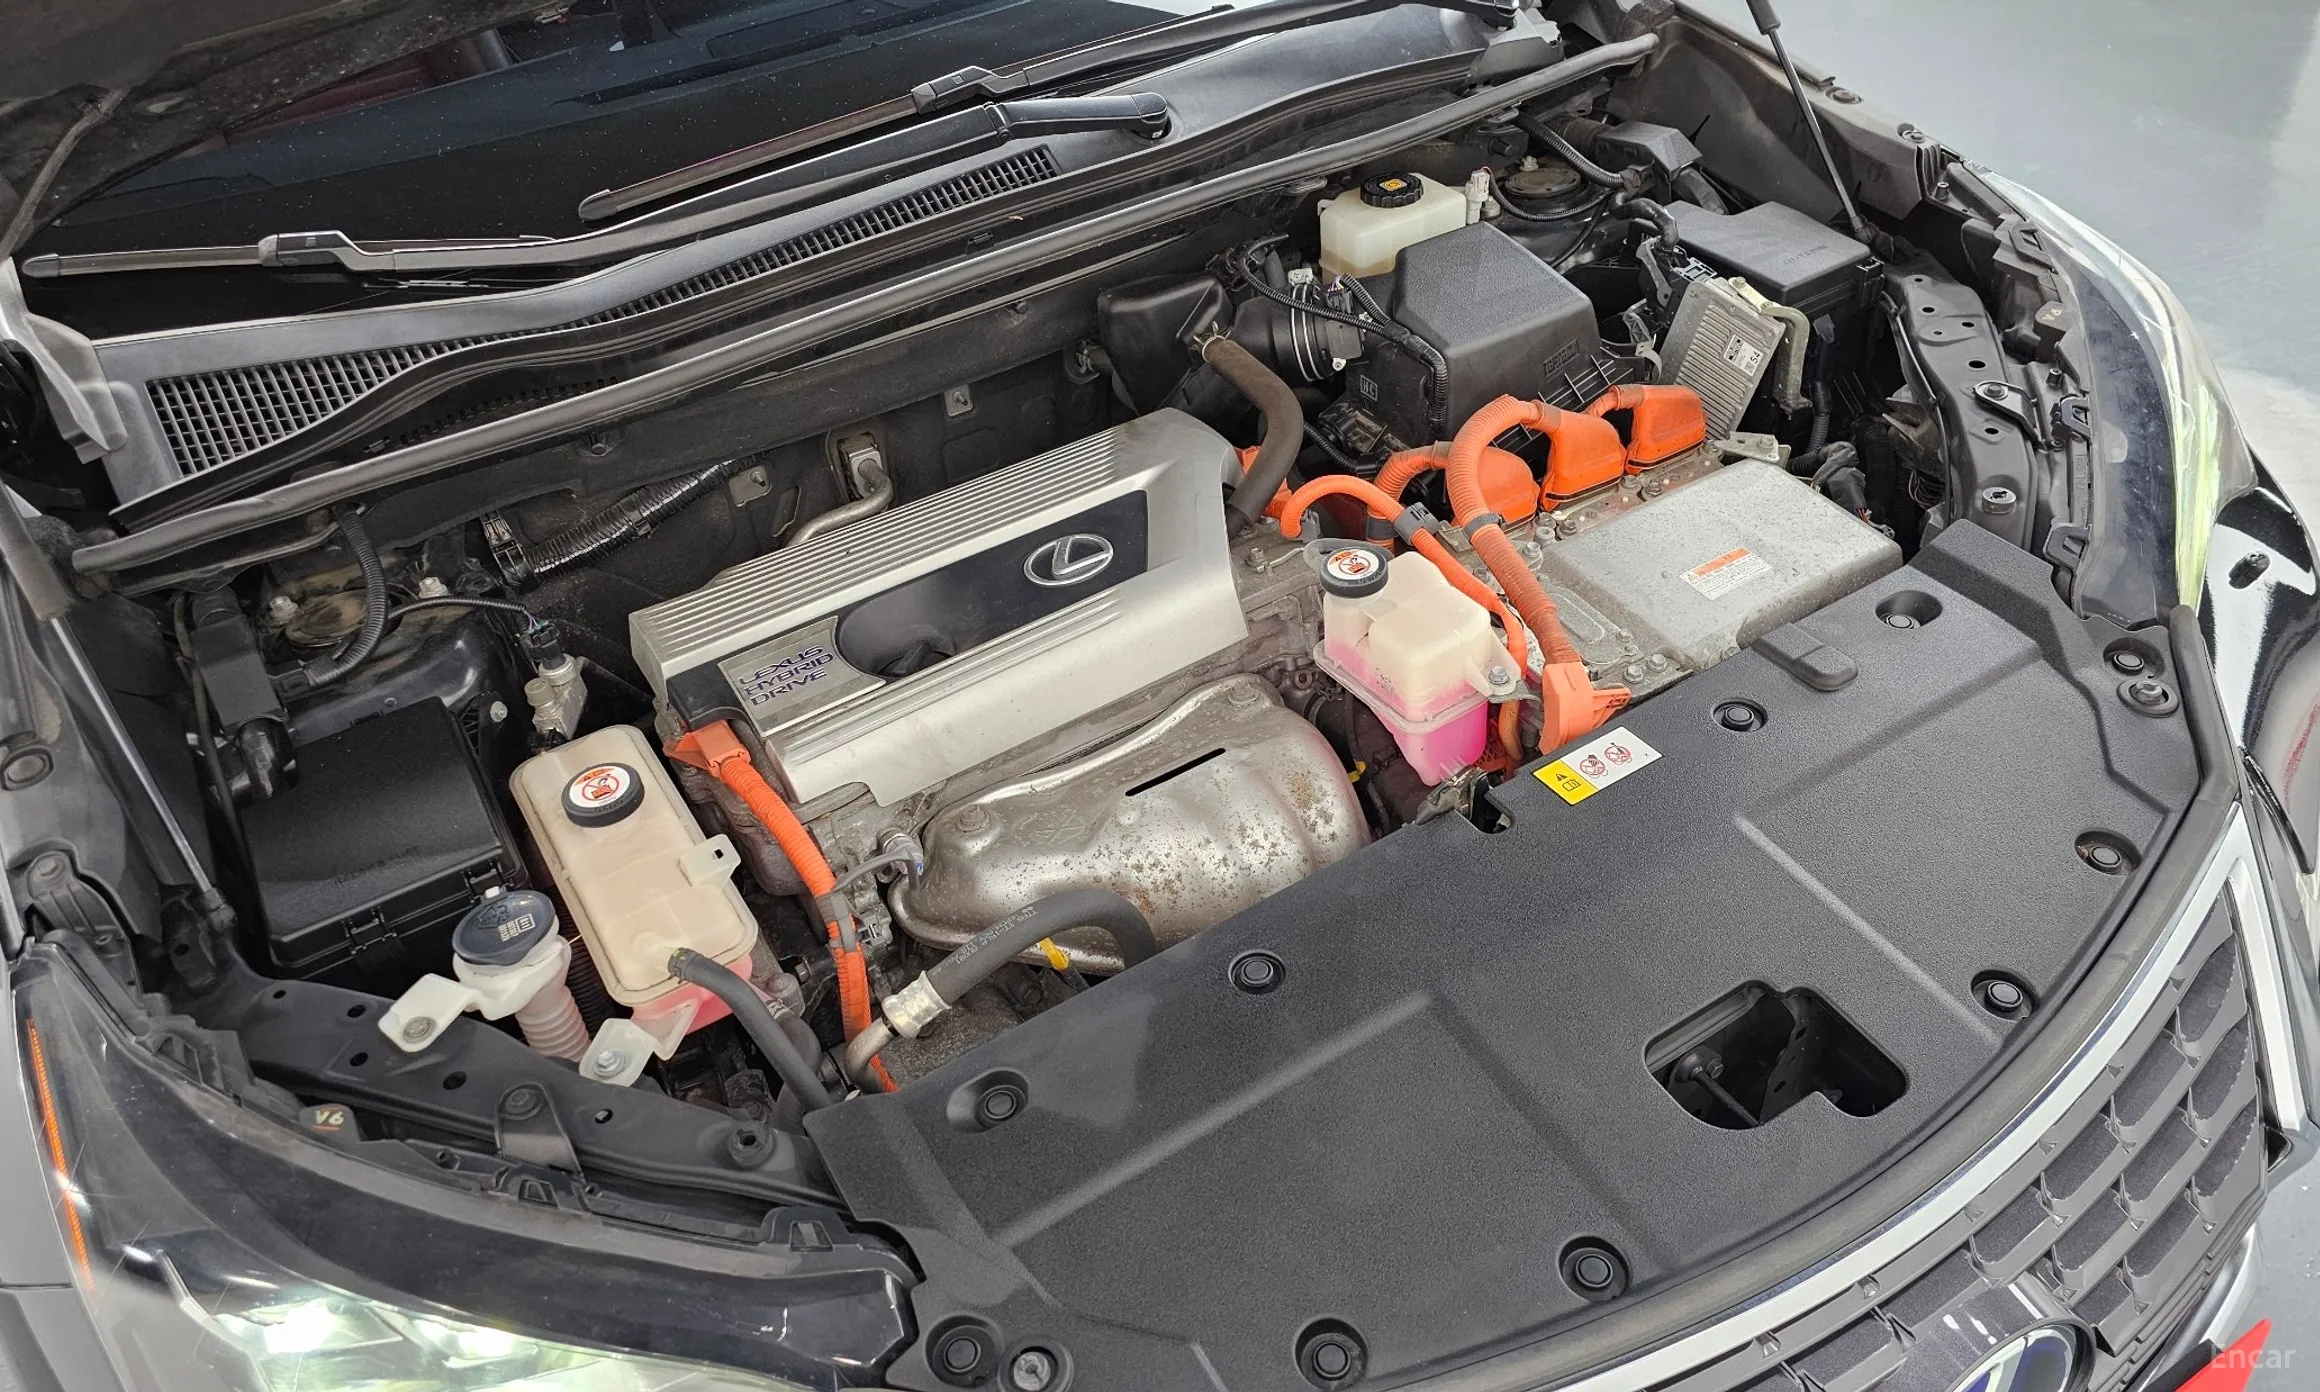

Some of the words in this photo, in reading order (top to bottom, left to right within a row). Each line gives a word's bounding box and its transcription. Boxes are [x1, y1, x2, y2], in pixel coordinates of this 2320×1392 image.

[739, 644, 823, 685] LEXUS
[744, 653, 834, 696] HYBRID
[750, 666, 828, 706] DRIVE
[315, 1110, 344, 1126] V6
